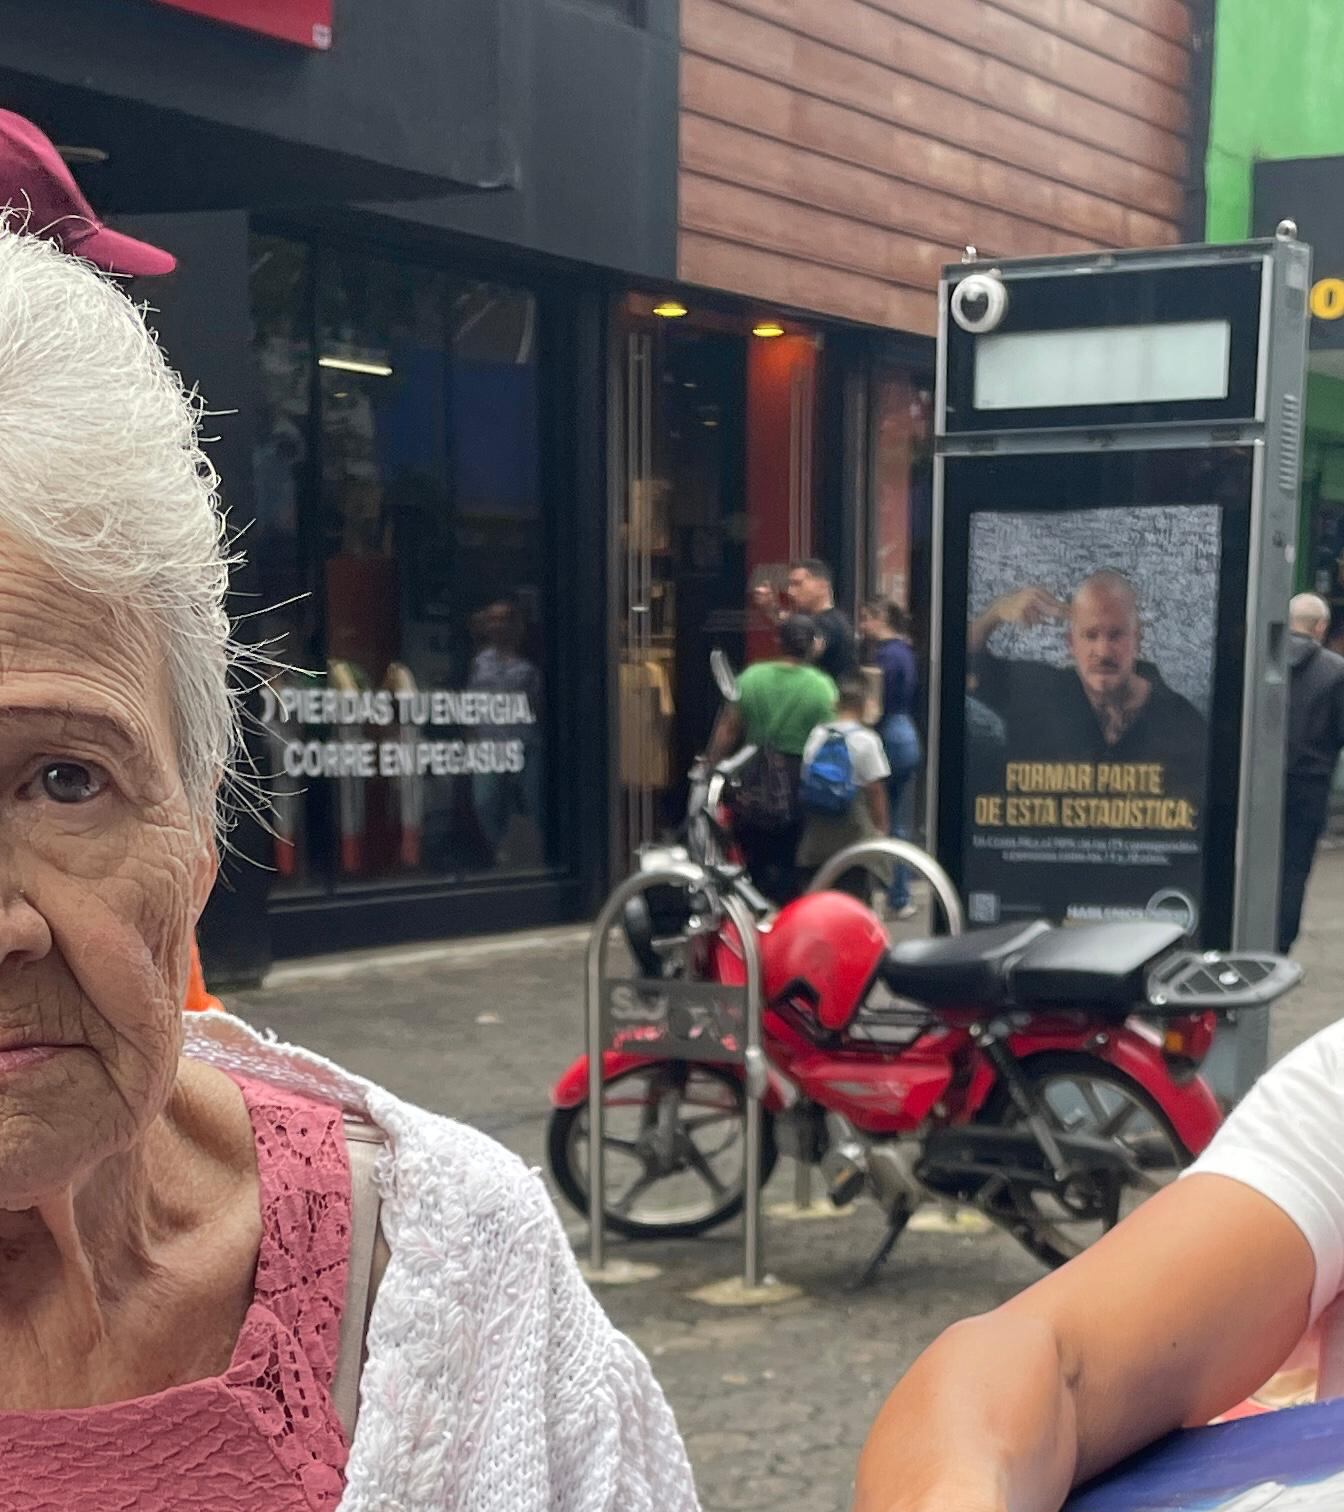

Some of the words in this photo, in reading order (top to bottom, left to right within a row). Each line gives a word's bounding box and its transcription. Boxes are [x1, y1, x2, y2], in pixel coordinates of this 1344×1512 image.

[279, 688, 394, 725] PIERDAS
[394, 689, 430, 724] TU
[283, 741, 377, 777] CORRE
[379, 742, 415, 777] EN
[416, 740, 525, 775] PEGASUS
[1006, 763, 1093, 792] FORMAR
[1096, 763, 1164, 793] PARTE
[975, 796, 1003, 826] DE
[1006, 797, 1058, 827] ESTA
